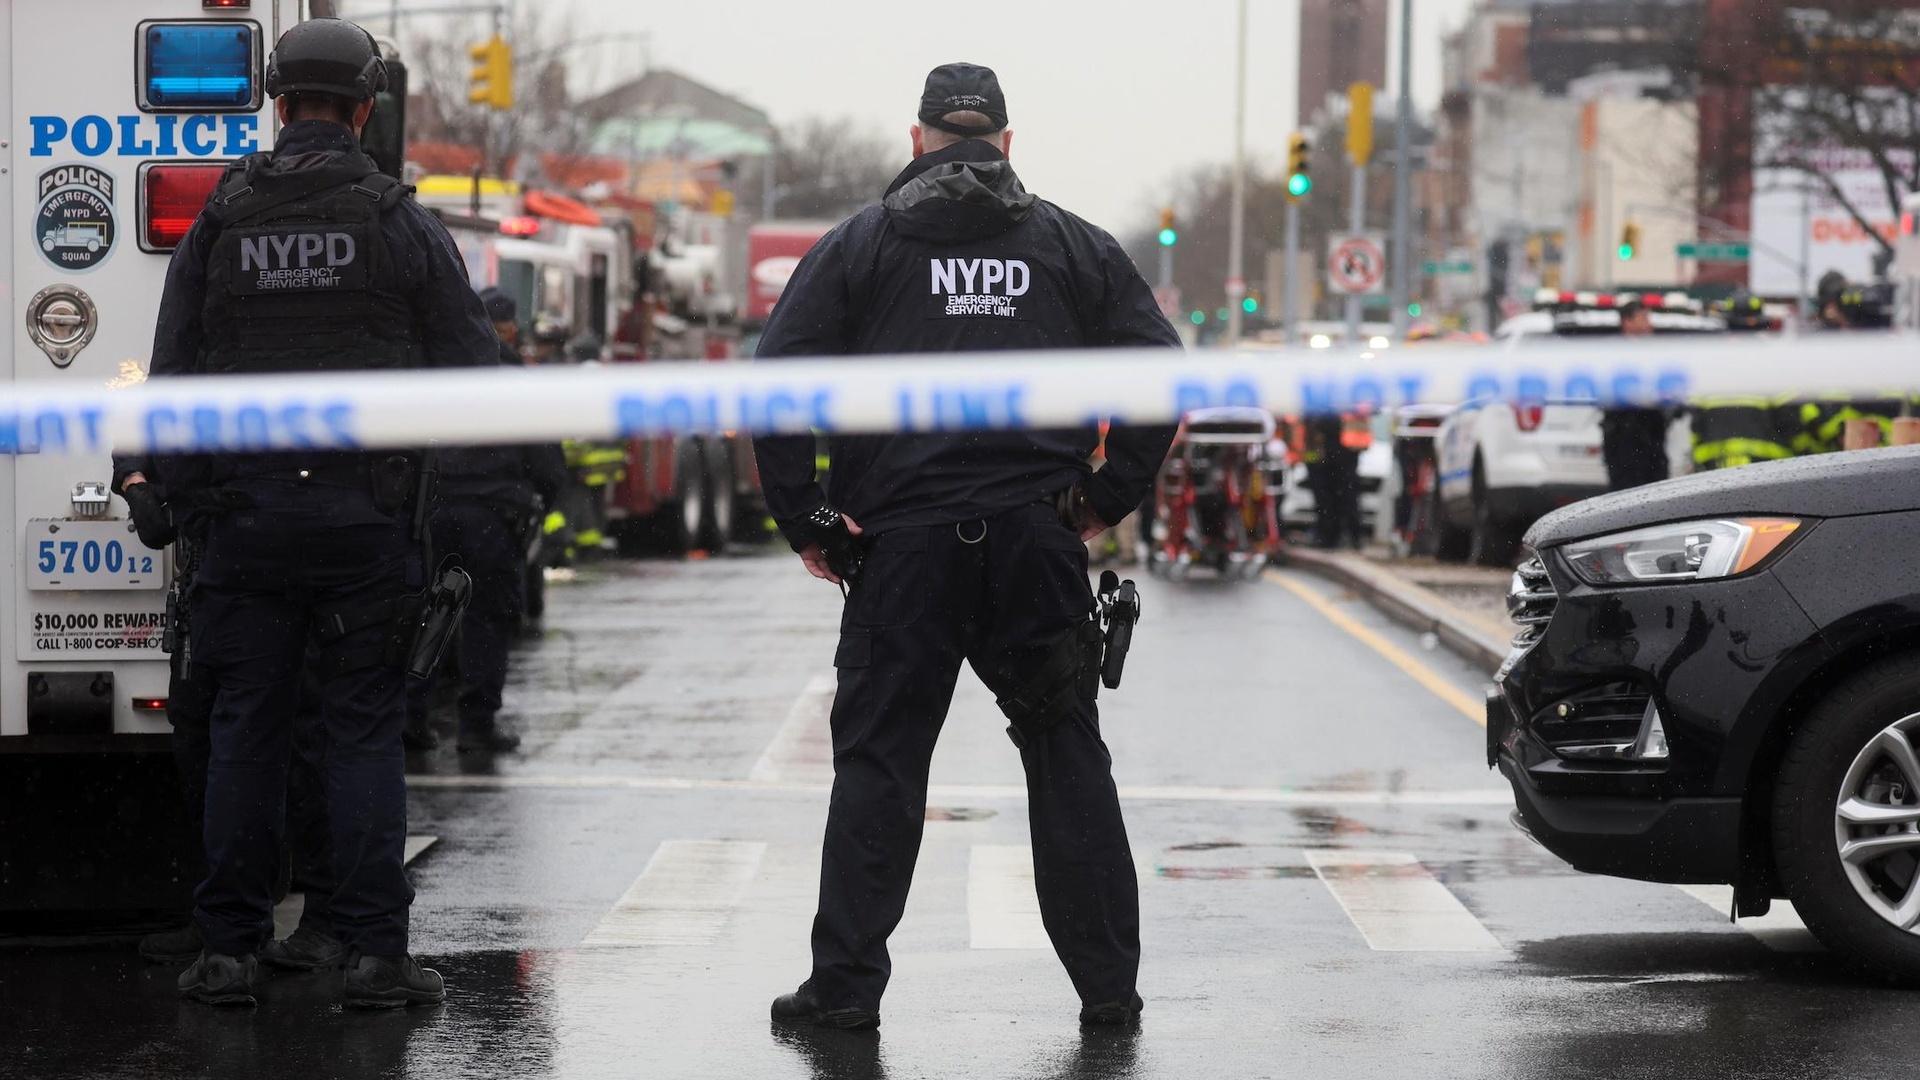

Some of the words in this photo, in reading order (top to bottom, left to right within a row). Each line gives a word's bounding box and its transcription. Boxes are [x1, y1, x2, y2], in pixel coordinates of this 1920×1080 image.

[29, 114, 259, 157] POLICE
[41, 167, 111, 197] POLICE
[43, 191, 109, 218] EMERGENCY
[63, 209, 90, 218] NYPD
[62, 252, 91, 261] SQUAD
[240, 232, 356, 271] NYPD
[256, 278, 309, 289] SERVICE
[312, 276, 342, 287] UNIT
[260, 267, 336, 280] EMERGENCY
[930, 258, 1030, 296] NYPD
[948, 294, 1013, 306] EMERGENCY
[945, 304, 992, 315] SERVICE
[993, 305, 1017, 317] UNIT
[142, 397, 357, 452] CROSS
[613, 387, 834, 436] POLICE
[39, 540, 123, 573] 5700
[128, 556, 152, 573] 12
[34, 612, 99, 632] $10,000
[103, 612, 168, 629] REWARD
[37, 638, 60, 649] CALL
[65, 638, 92, 649] 1-800
